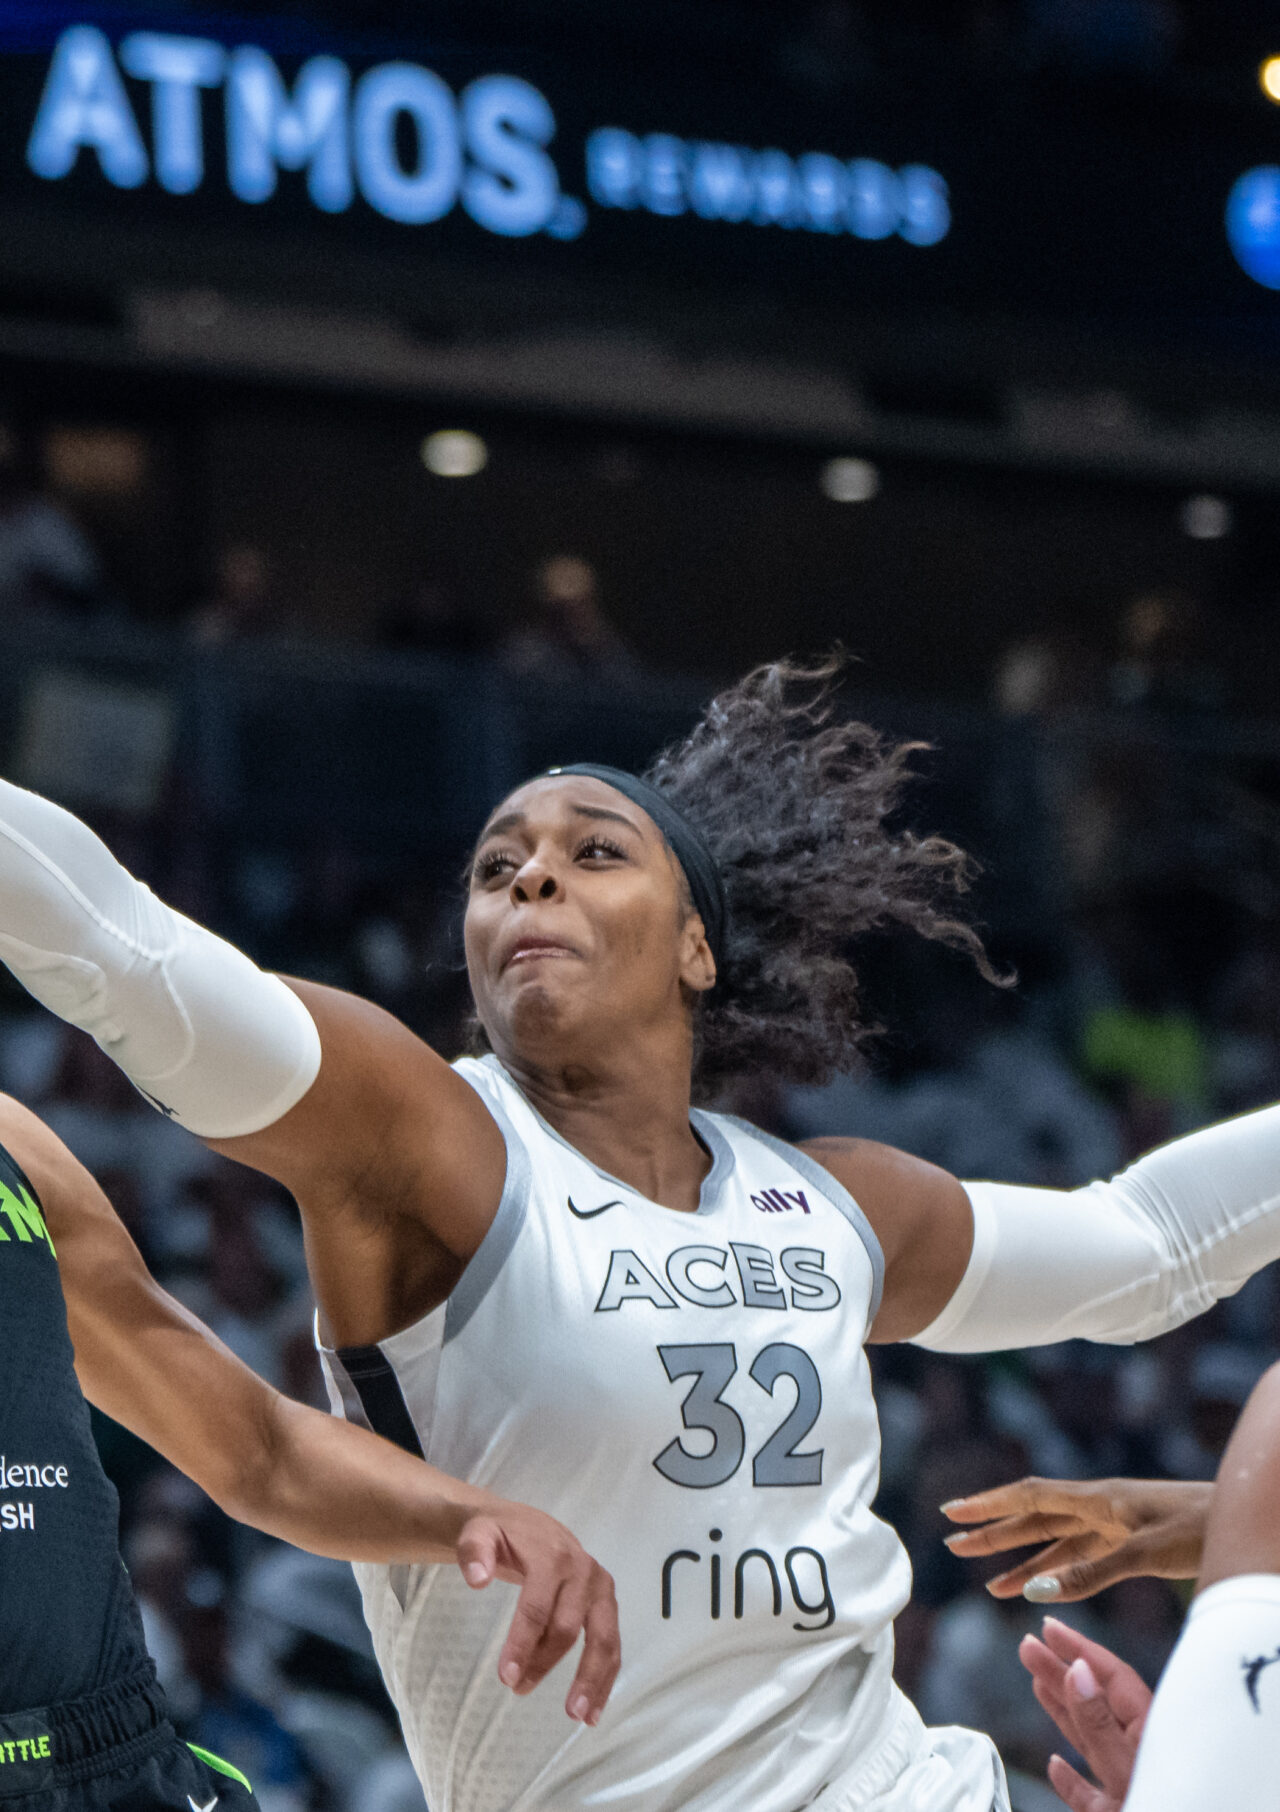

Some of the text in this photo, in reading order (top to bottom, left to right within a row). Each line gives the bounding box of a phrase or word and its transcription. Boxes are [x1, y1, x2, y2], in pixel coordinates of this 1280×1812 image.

[586, 127, 951, 247] REWARDS
[750, 1188, 811, 1214] ally
[594, 1242, 842, 1313] ACES
[651, 1342, 825, 1490] 32
[661, 1528, 836, 1632] ring
